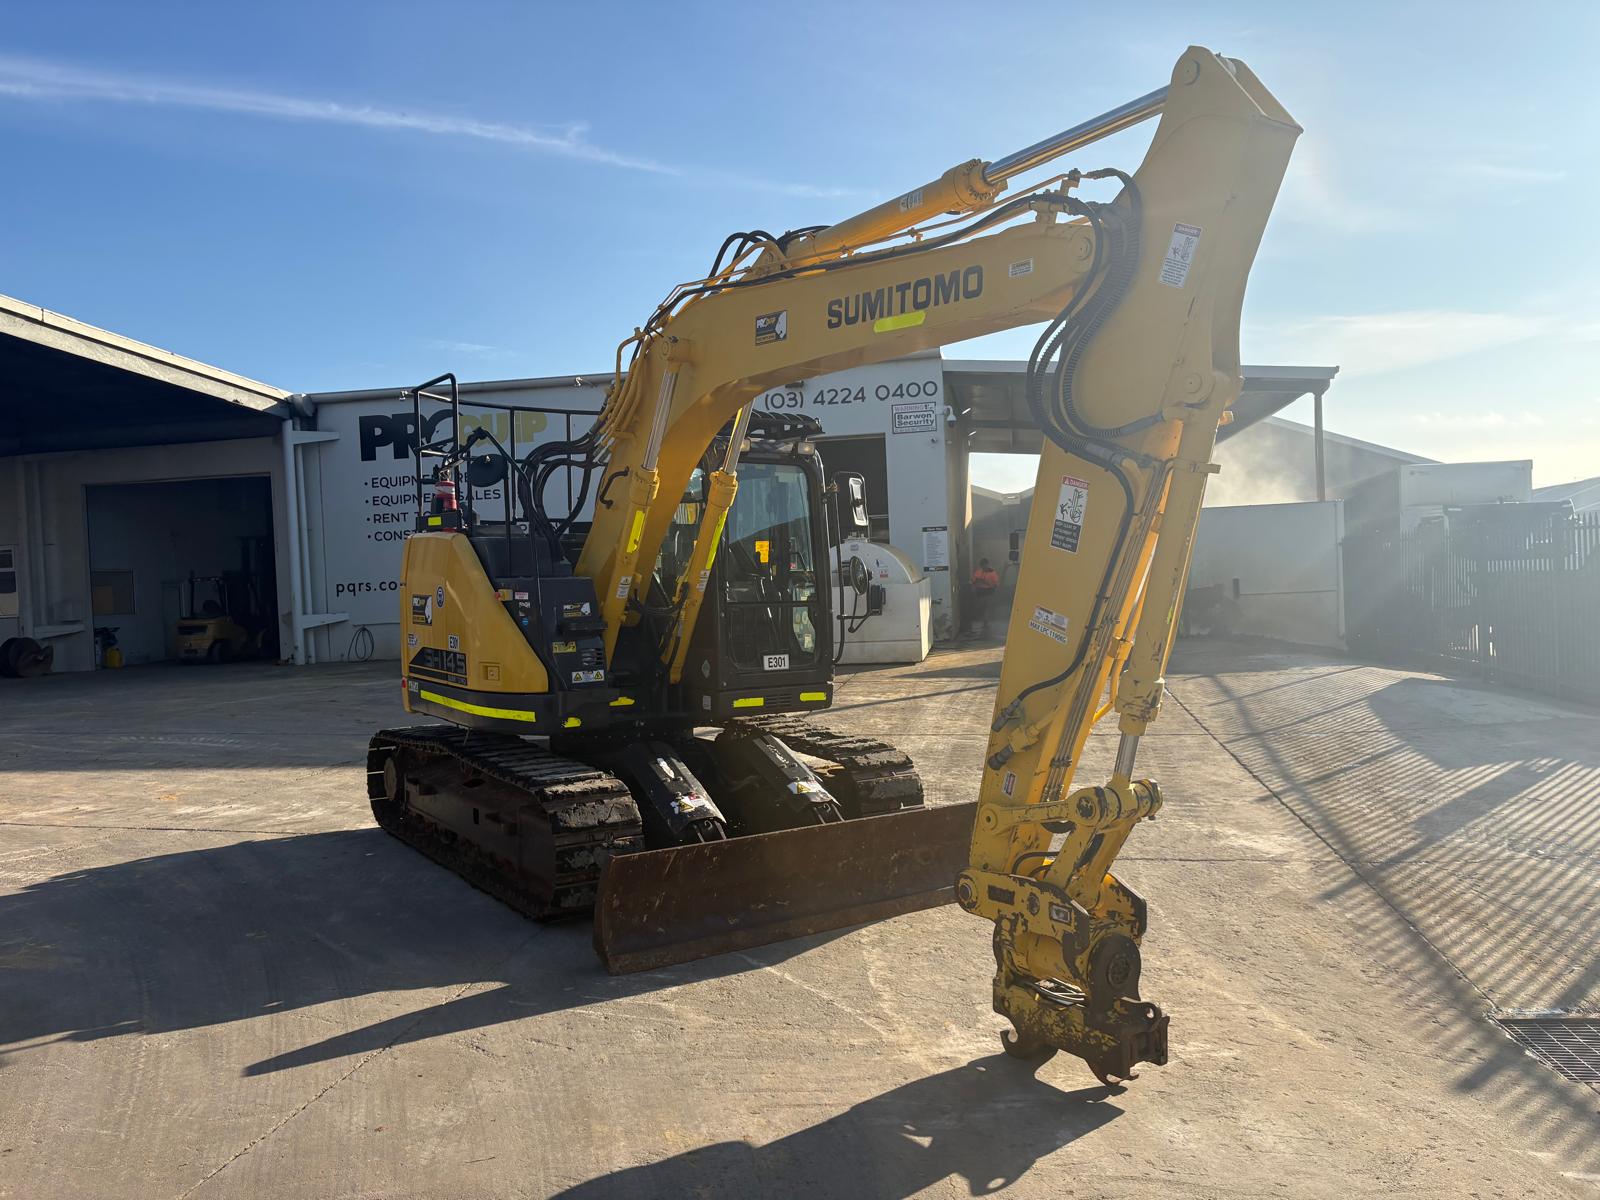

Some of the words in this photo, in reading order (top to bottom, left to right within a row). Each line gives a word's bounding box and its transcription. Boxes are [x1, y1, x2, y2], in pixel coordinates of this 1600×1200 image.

[827, 264, 983, 329] SUMITOMO
[765, 391, 804, 411] (03)
[812, 386, 866, 406] 4224
[874, 380, 938, 401] 0400
[896, 412, 932, 420] Barwon
[896, 418, 935, 427] Security
[373, 512, 409, 524] RENT
[374, 529, 416, 542] CONS
[335, 580, 398, 597] pqrs.co
[768, 656, 786, 668] E301
